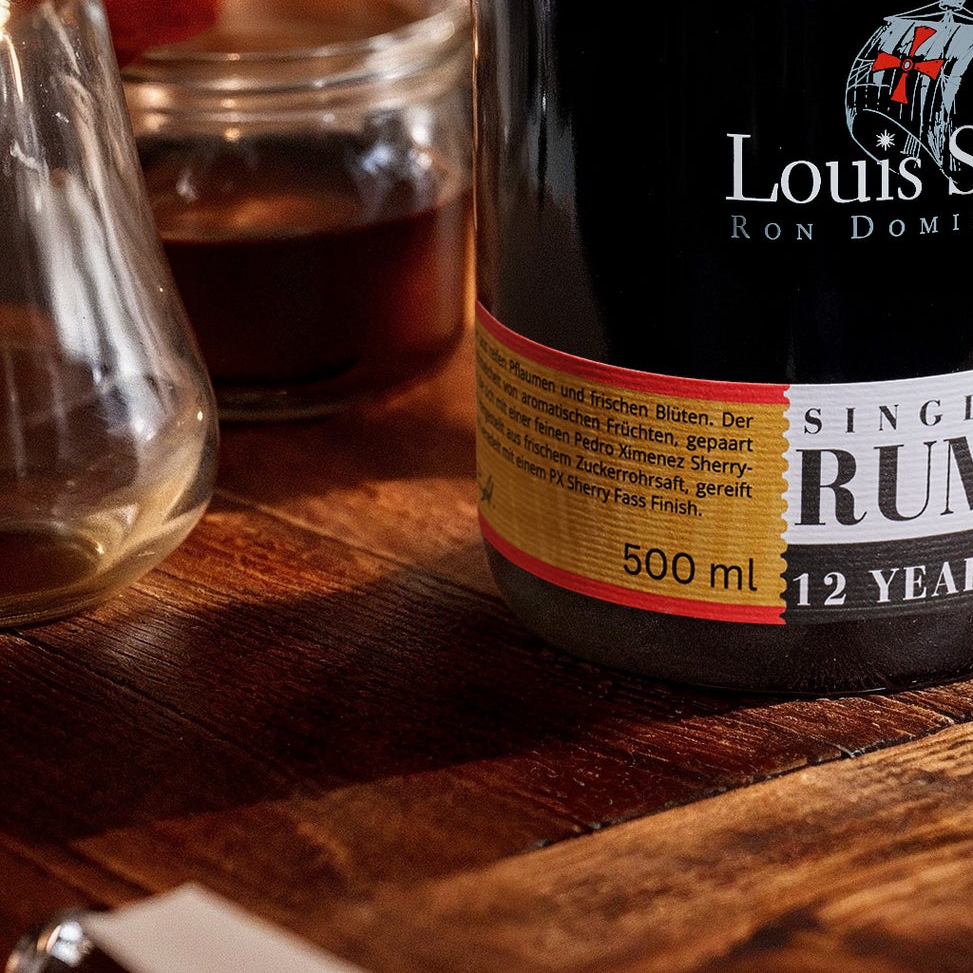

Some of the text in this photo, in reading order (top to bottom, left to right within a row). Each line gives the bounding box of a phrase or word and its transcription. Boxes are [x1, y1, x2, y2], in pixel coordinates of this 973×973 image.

[725, 129, 923, 204] Louis
[731, 214, 814, 241] RON
[509, 359, 556, 393] Pflaumen
[560, 383, 585, 403] und
[590, 390, 648, 418] frischen
[656, 403, 714, 426] Blüten.
[722, 411, 754, 429] Der
[521, 392, 600, 430] aromatischen
[607, 418, 679, 447] Früchten,
[686, 434, 754, 453] gepaart
[509, 406, 532, 429] einer
[535, 416, 570, 444] feinen
[574, 430, 614, 457] Pedro
[618, 441, 685, 469] Ximenez
[691, 455, 753, 479] Sherry-
[524, 434, 572, 468] frischem
[575, 453, 689, 495] Zuckerrohrsaft,
[695, 481, 753, 499] gereift
[516, 454, 546, 481] einem
[550, 468, 564, 488] PX
[567, 474, 611, 504] Sherry
[614, 488, 647, 508] Fass
[651, 494, 703, 517] Finish.
[623, 542, 758, 591] 500 ml
[793, 570, 848, 607] 12
